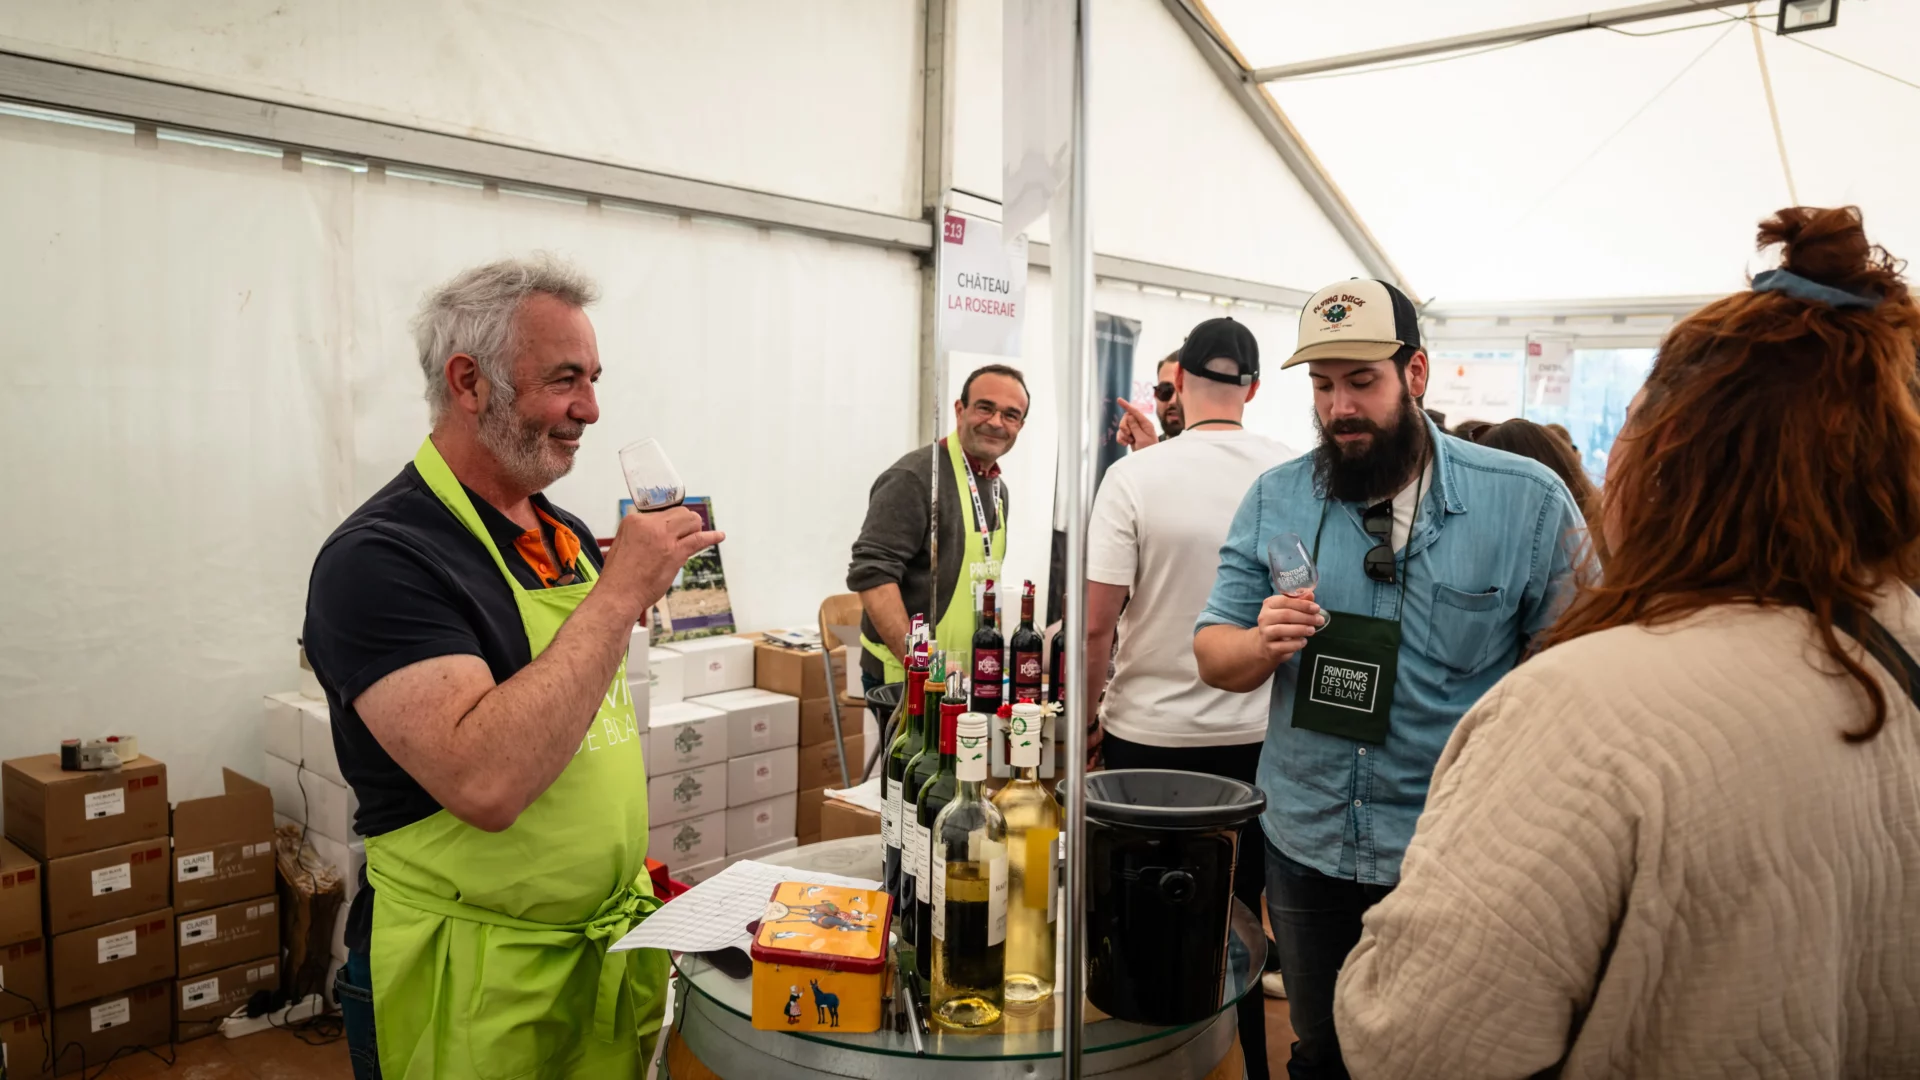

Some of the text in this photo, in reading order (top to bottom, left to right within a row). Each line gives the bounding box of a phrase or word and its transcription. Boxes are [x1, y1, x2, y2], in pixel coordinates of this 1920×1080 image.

[944, 222, 963, 239] C13
[957, 272, 1010, 294] CHÂTEAU
[948, 294, 1015, 318] LA ROSERAIE
[1323, 664, 1368, 682] PRINTEMPS
[1321, 675, 1367, 692] DES VINS
[1320, 685, 1364, 702] DE BLAYE
[183, 854, 210, 866] CLAIRET
[186, 918, 213, 930] CLAIRET
[188, 981, 215, 993] CLAIRET
